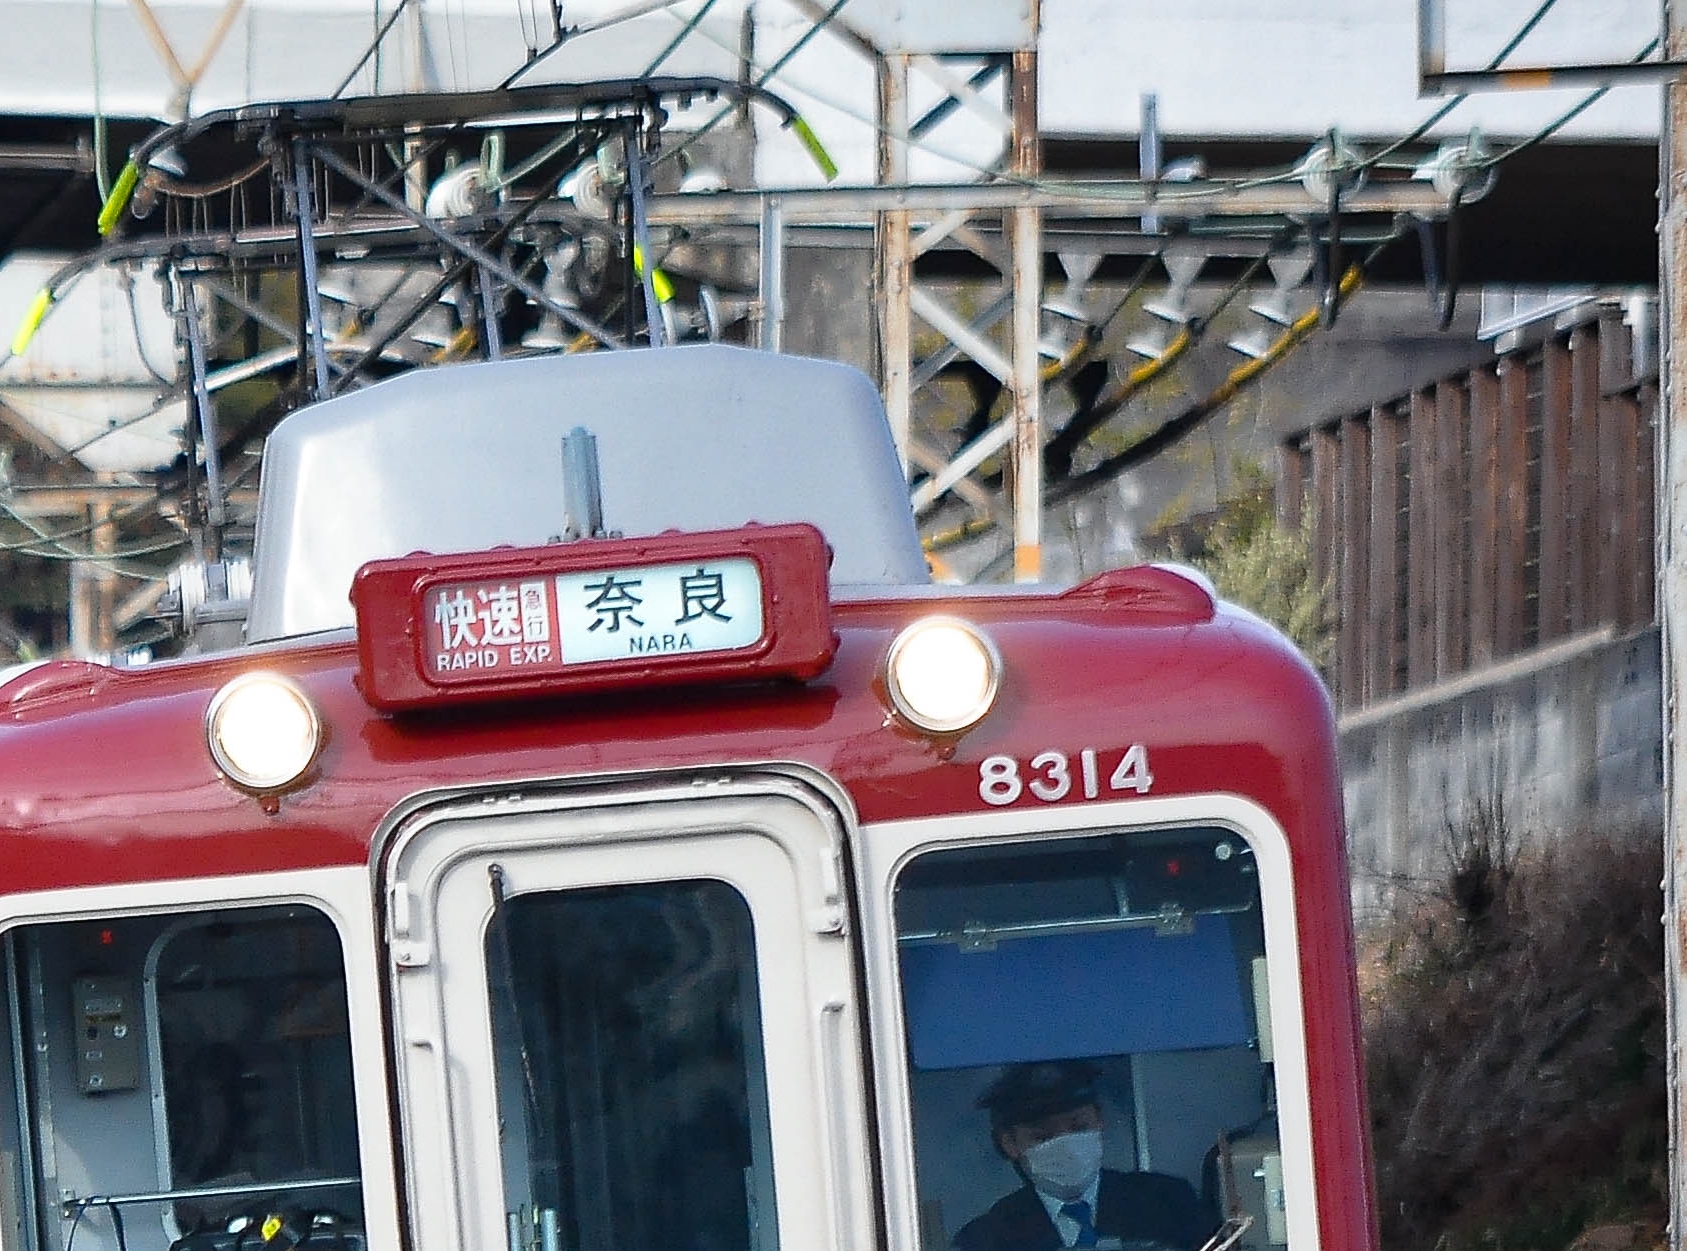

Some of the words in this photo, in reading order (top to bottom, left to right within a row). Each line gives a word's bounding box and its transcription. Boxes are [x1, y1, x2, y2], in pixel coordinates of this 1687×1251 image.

[435, 585, 522, 650] 快速
[524, 588, 546, 637] 急行
[584, 568, 732, 632] 奈良
[436, 648, 499, 671] RAPID
[510, 645, 554, 666] EXP.
[629, 633, 694, 653] NARA
[979, 743, 1154, 805] 8314
